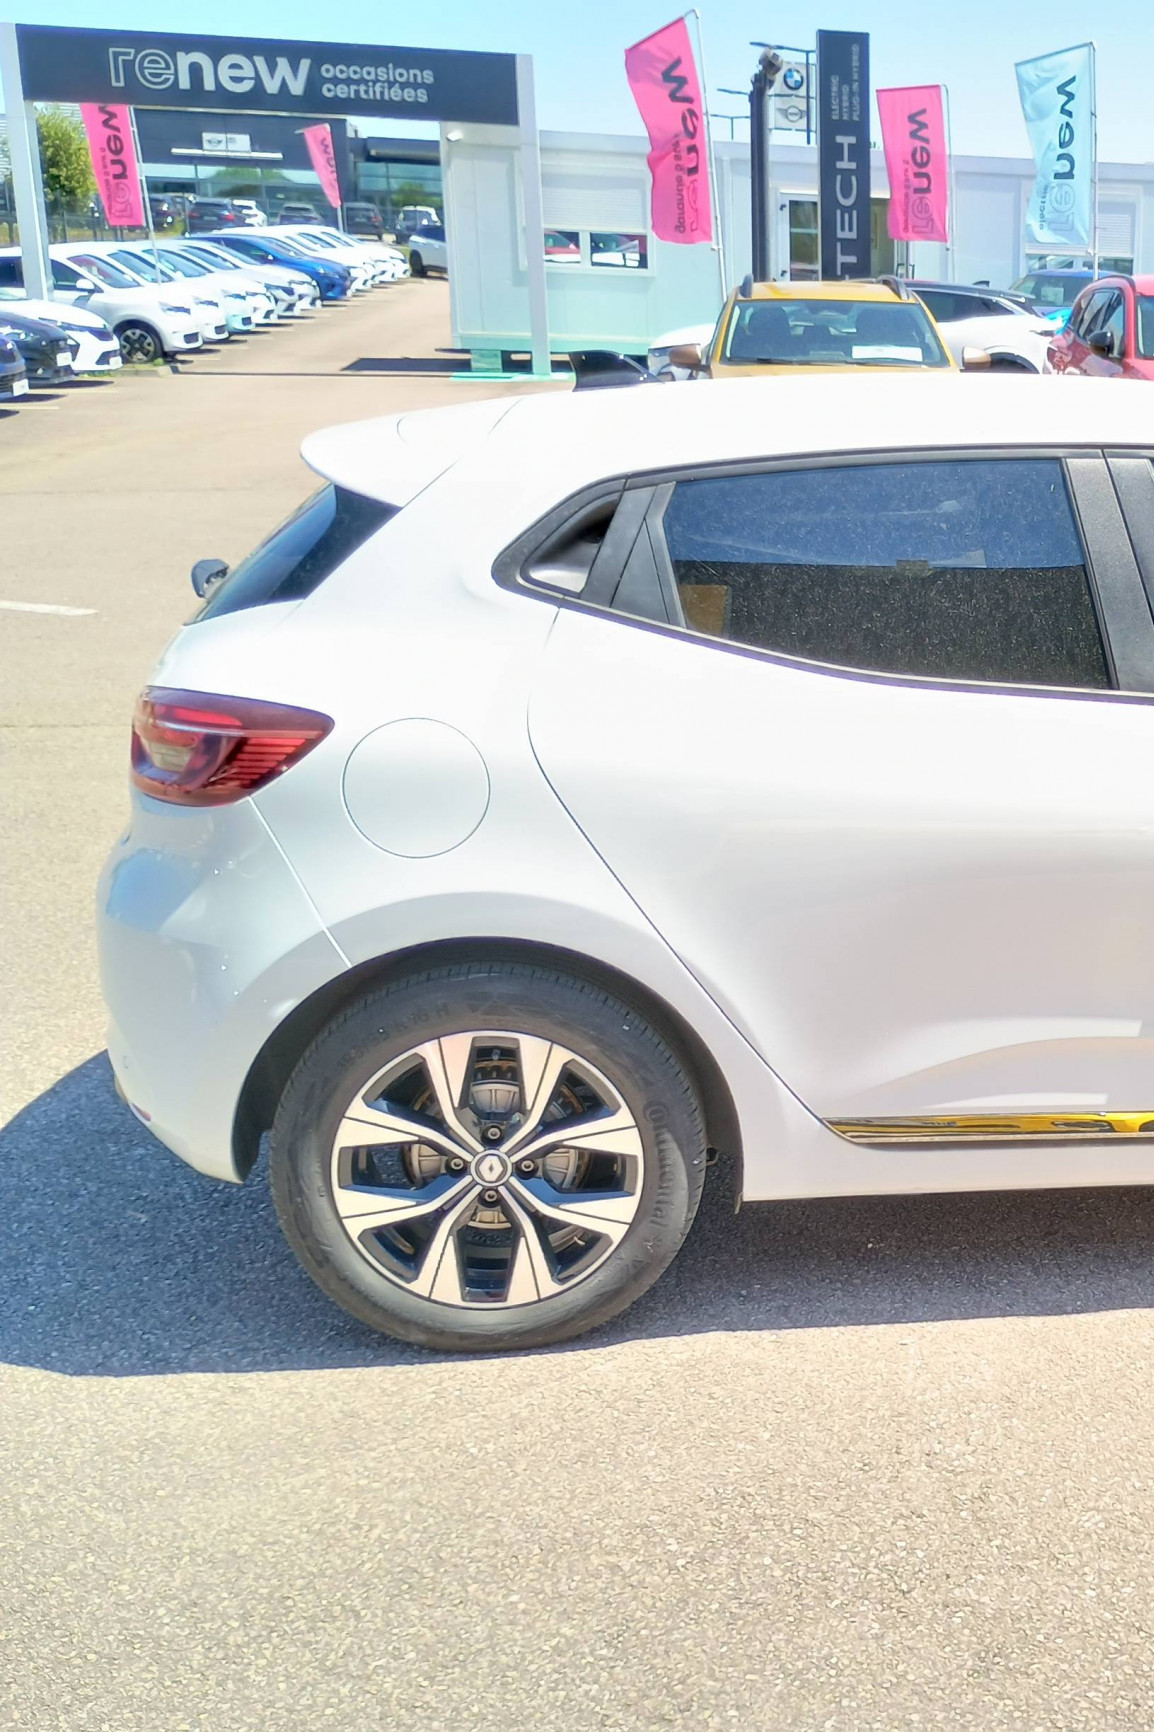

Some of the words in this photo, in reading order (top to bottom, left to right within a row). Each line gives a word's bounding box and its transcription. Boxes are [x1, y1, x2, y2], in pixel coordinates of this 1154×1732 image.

[108, 47, 311, 96] renew
[320, 62, 434, 84] occasions
[321, 81, 429, 103] certifiées
